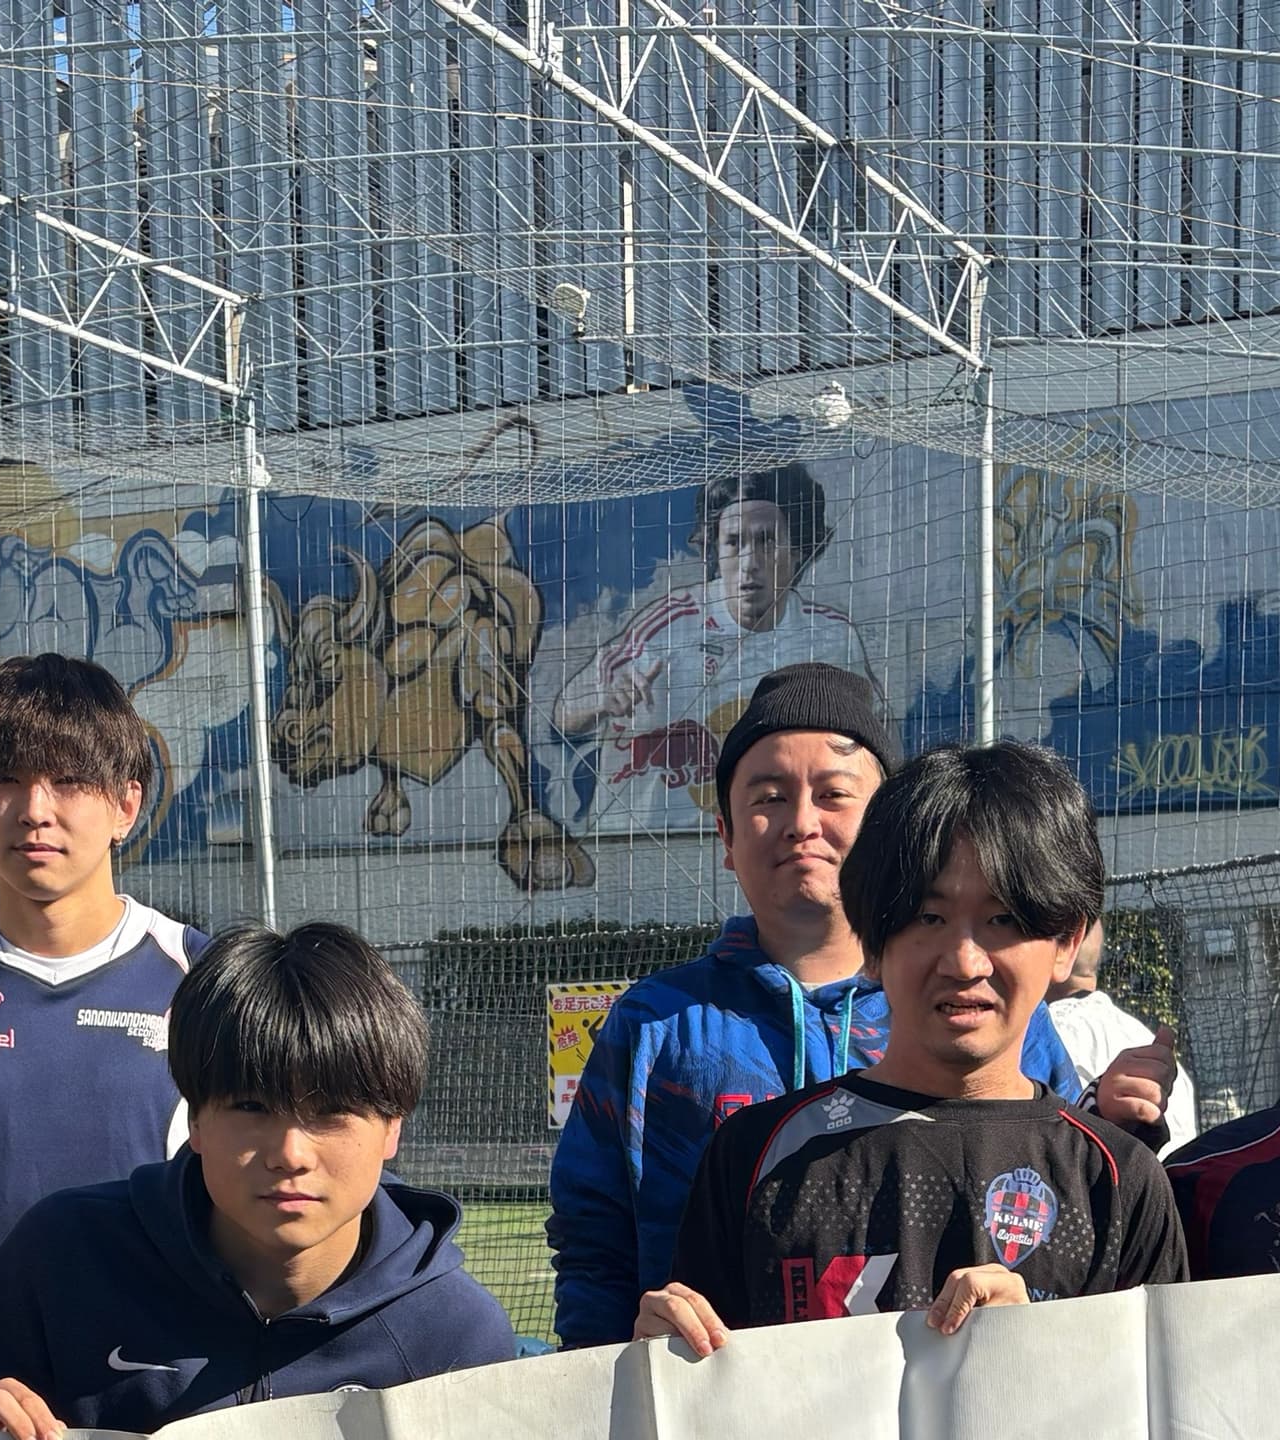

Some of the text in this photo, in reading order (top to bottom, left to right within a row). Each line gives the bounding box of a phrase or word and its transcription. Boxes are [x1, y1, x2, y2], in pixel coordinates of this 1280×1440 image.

[553, 994, 622, 1011] お足元ご注
